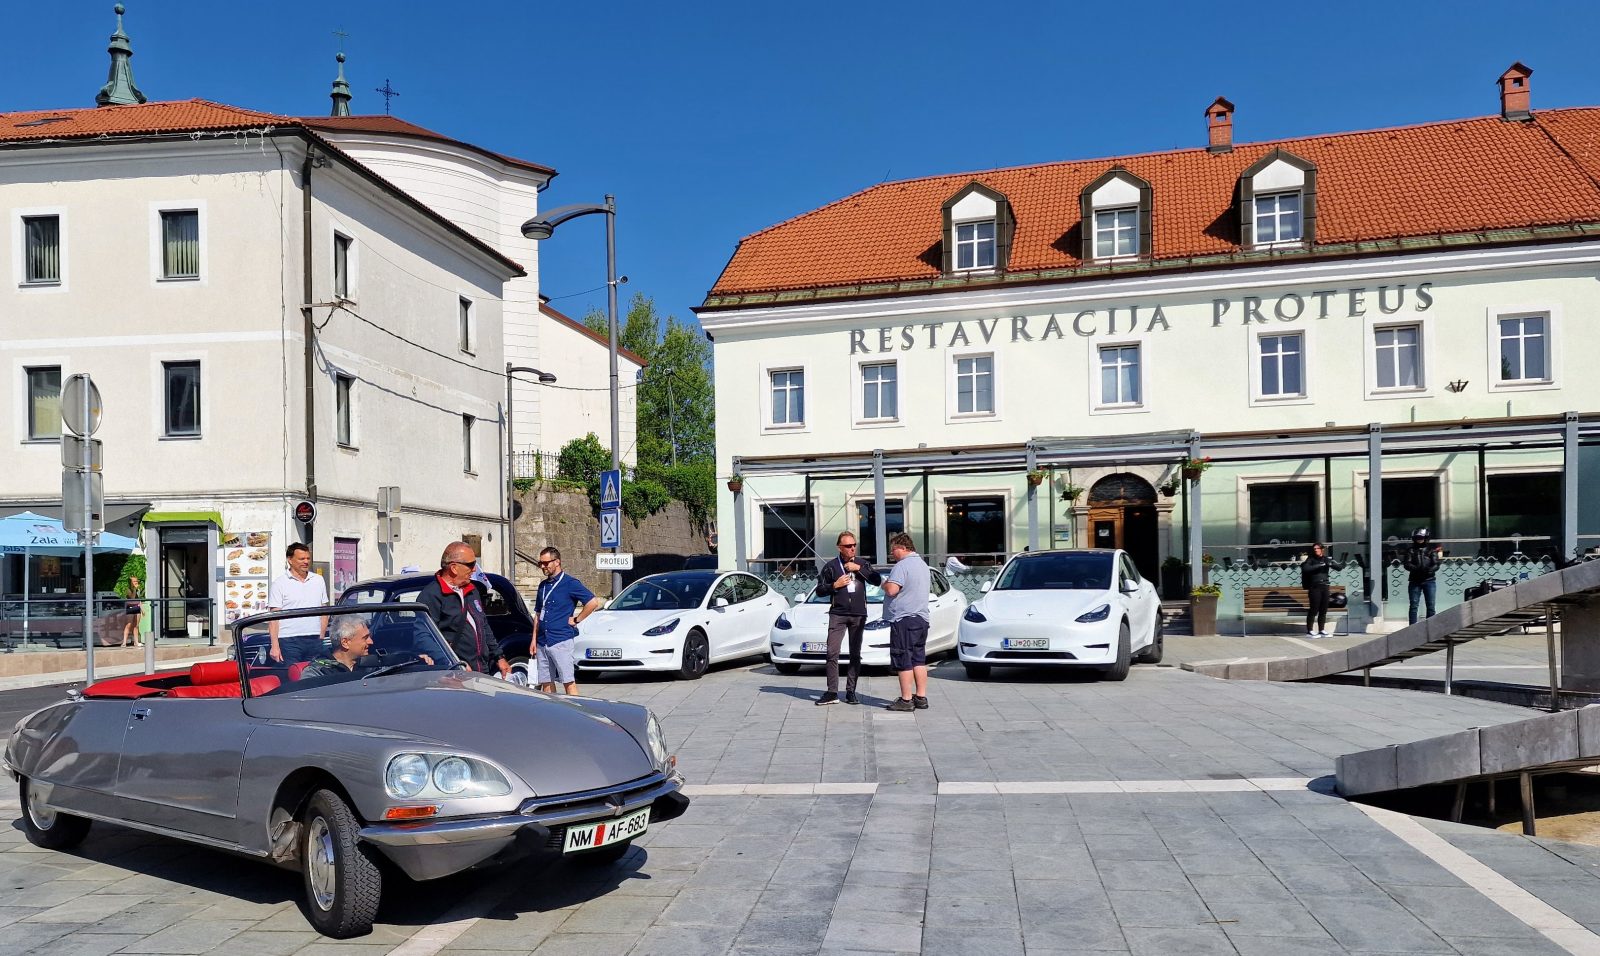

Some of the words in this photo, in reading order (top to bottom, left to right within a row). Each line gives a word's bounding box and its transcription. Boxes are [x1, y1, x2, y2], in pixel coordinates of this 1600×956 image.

[848, 303, 1171, 355] RESTAVRACIJA
[1211, 282, 1433, 328] PROTEUS
[31, 536, 58, 544] Zala
[600, 557, 629, 565] PROTEUS
[570, 829, 593, 848] NM
[608, 812, 646, 841] AF-683
